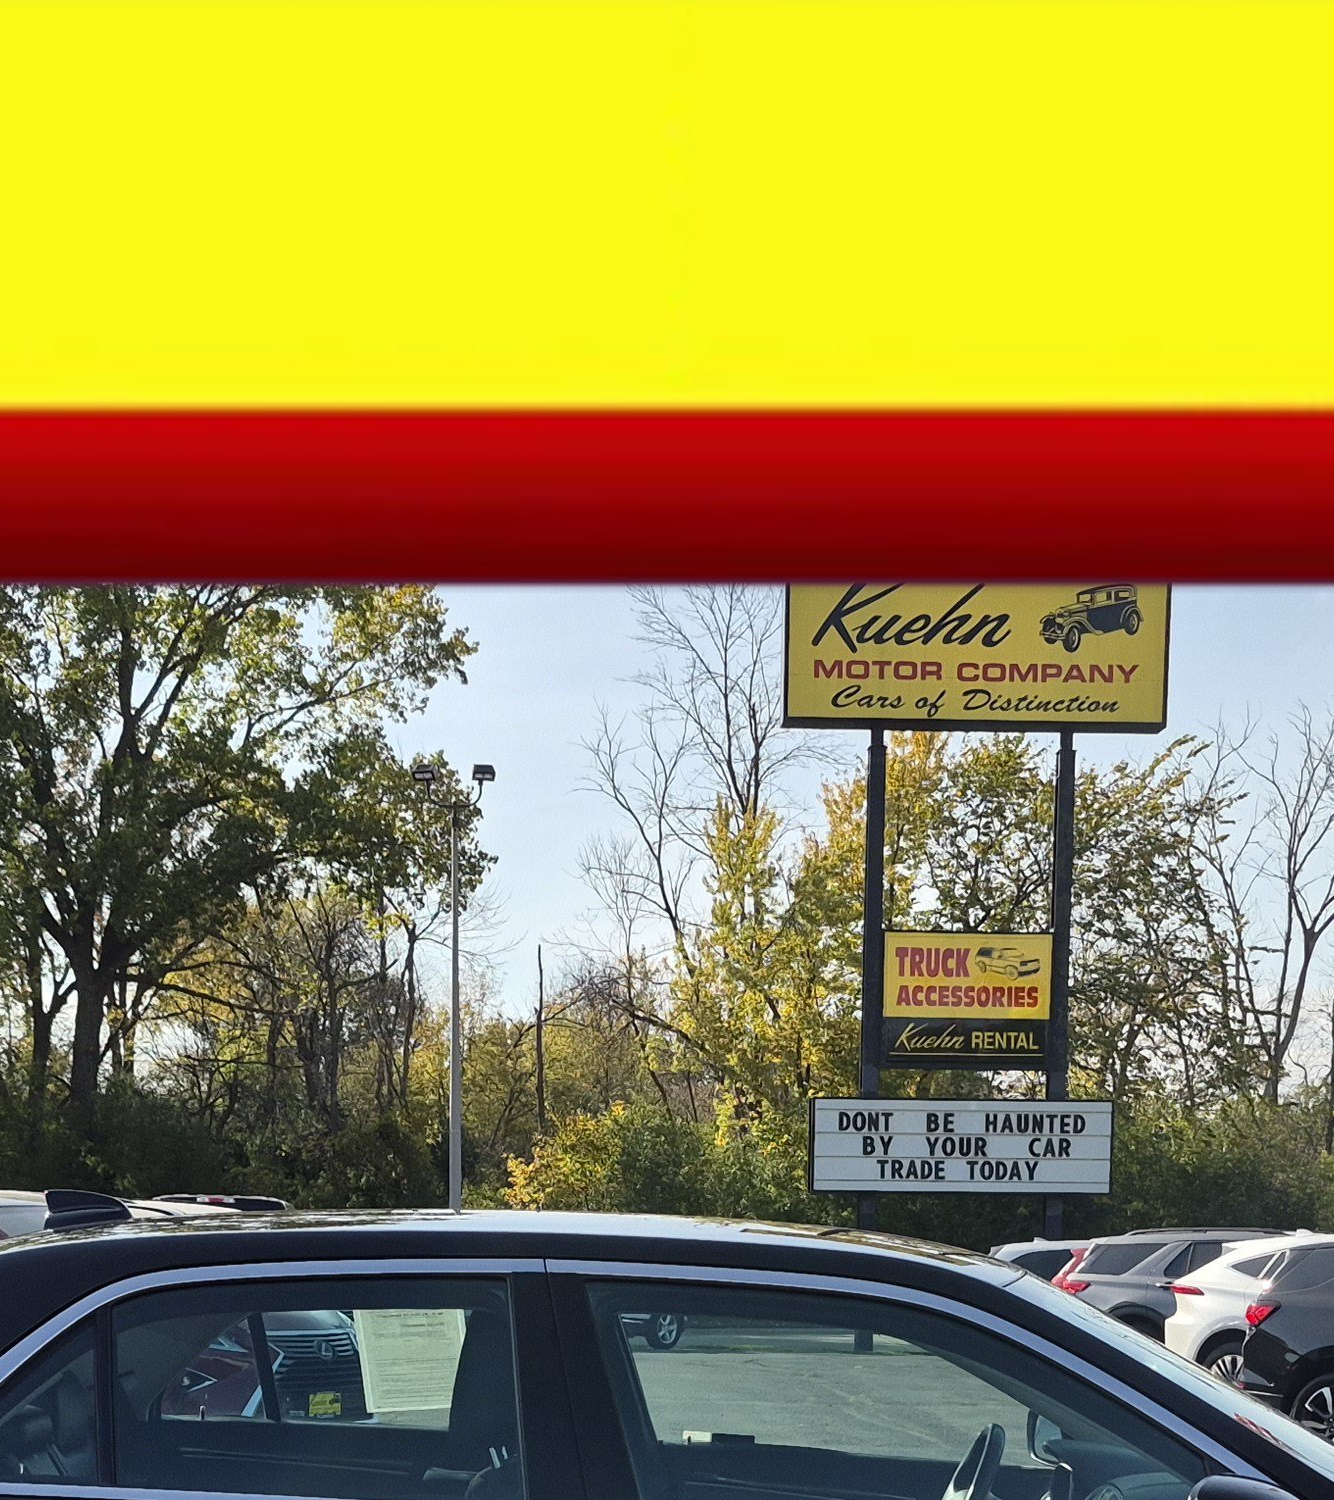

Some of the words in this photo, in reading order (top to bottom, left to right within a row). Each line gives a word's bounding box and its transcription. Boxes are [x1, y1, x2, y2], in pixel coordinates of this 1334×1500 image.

[811, 583, 1012, 653] Kuehn
[813, 659, 943, 681] MOTOR
[956, 662, 1140, 684] COMPANY
[830, 684, 906, 710] Cars
[914, 689, 947, 718] of
[961, 688, 1120, 714] Distinction
[895, 946, 972, 978] TRUCK
[896, 985, 1039, 1009] ACCESSORIES
[894, 1022, 965, 1051] Kuehn
[971, 1031, 1040, 1050] RENTAL
[838, 1111, 894, 1132] DONT
[926, 1112, 955, 1133] BE
[984, 1113, 1087, 1134] HAUNTED
[862, 1136, 894, 1156] BY
[925, 1136, 988, 1158] YOUR
[1028, 1137, 1072, 1158] CAR
[877, 1159, 947, 1180] TRADE
[966, 1160, 1039, 1182] TODAY
